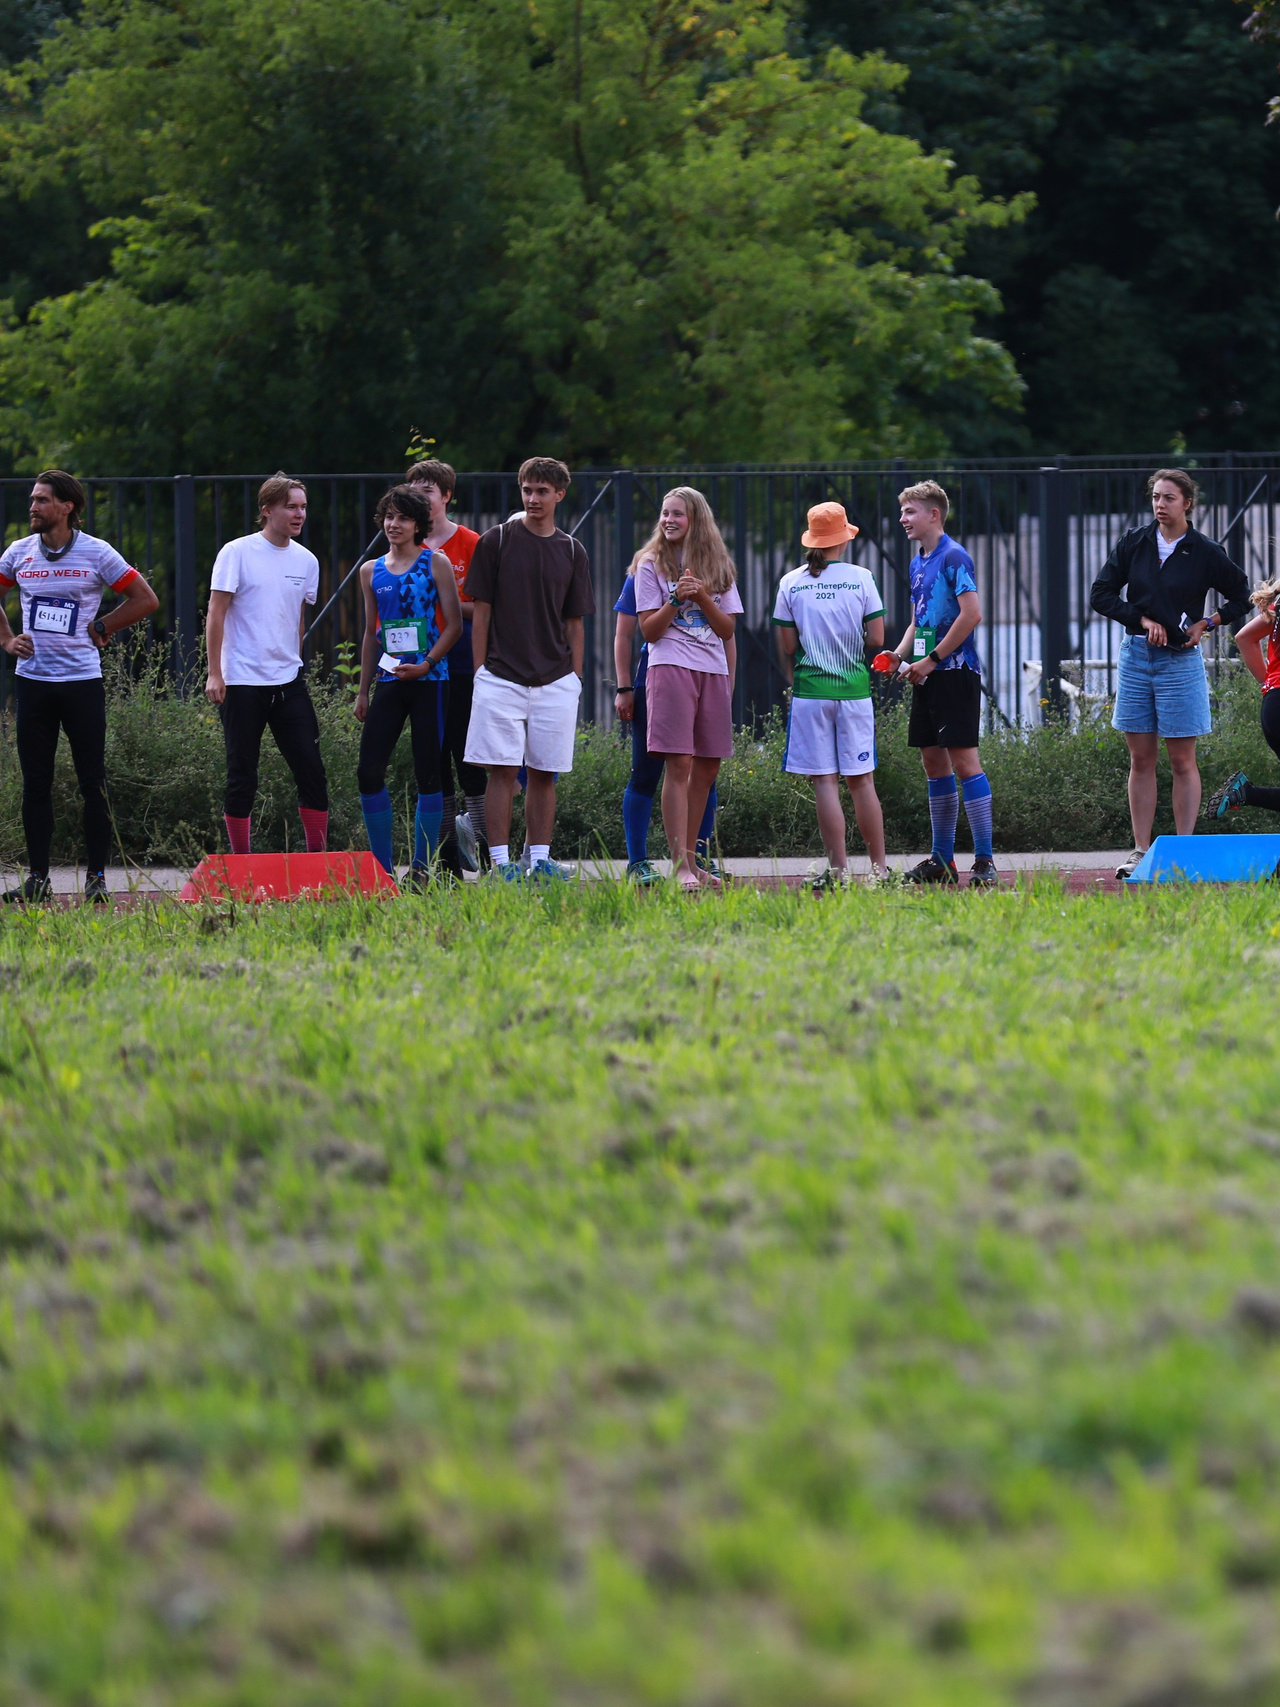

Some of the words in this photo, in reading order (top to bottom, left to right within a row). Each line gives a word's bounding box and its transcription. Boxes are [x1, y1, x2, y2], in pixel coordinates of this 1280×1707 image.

[18, 570, 49, 578] NORD
[53, 569, 90, 578] WEST
[790, 581, 861, 593] Санкт-Петербург
[815, 592, 835, 600] 2021
